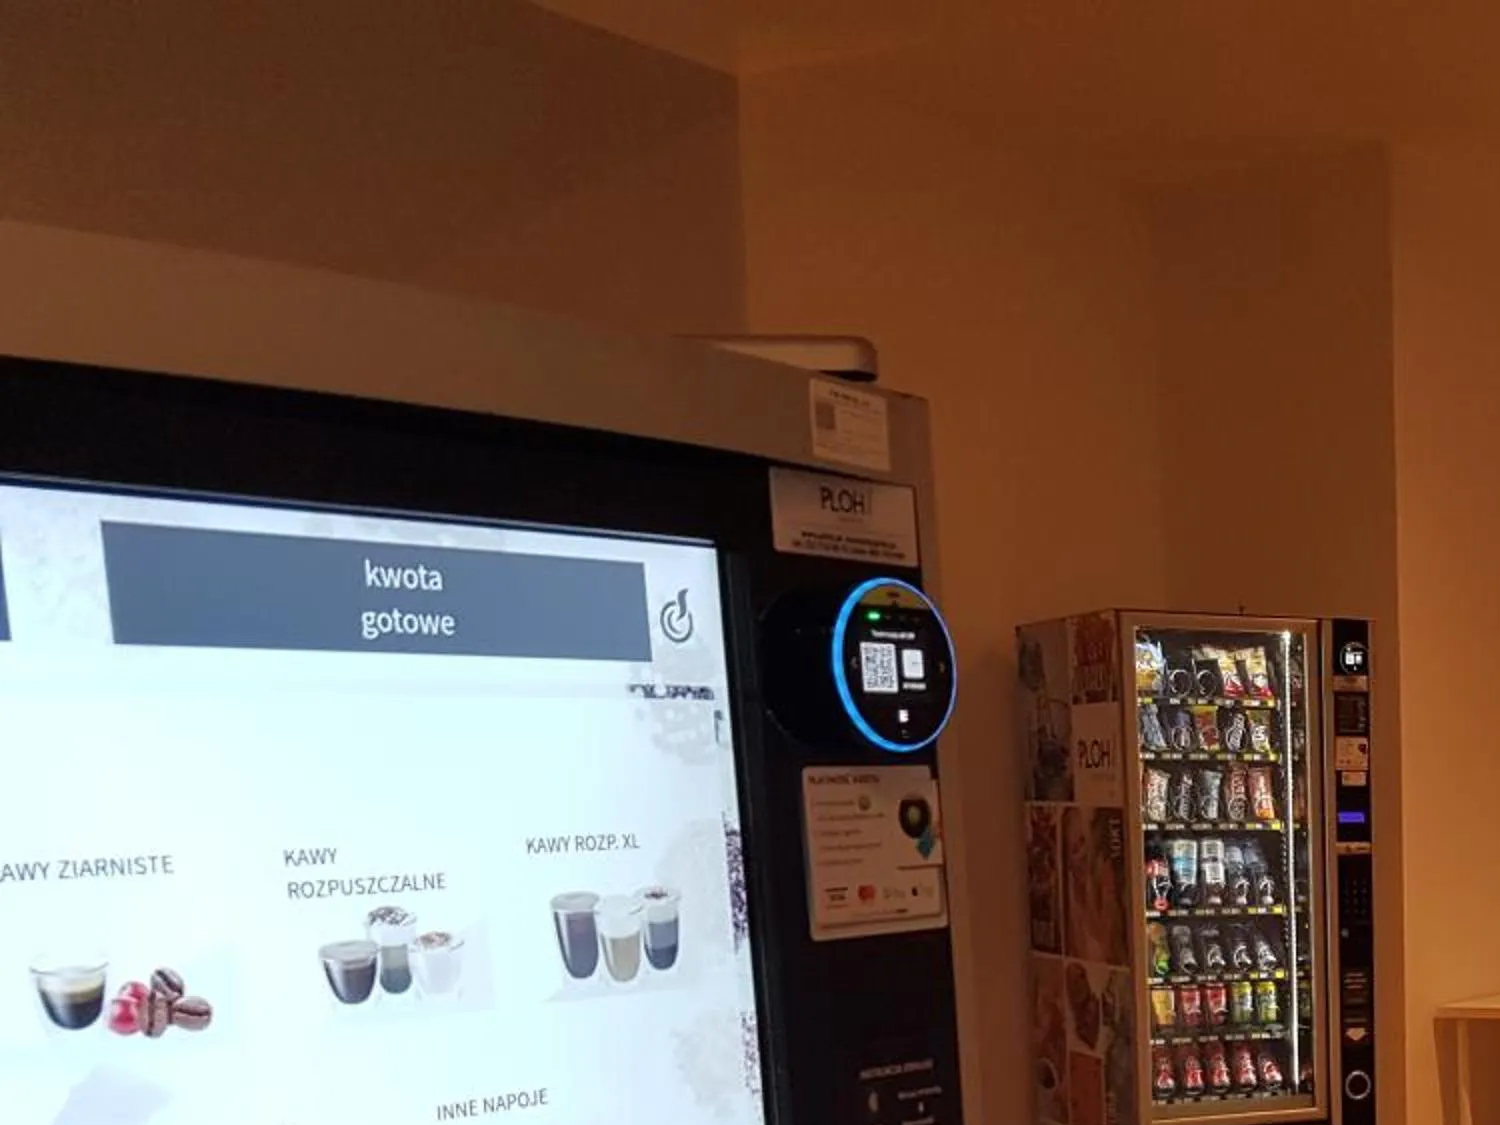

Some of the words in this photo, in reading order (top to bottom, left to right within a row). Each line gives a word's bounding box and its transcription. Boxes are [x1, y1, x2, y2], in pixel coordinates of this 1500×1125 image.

[364, 558, 443, 591] kwota
[361, 607, 456, 640] gotowe
[525, 834, 570, 854] KAWY
[574, 832, 620, 852] ROZP.
[621, 832, 641, 850] XL
[0, 860, 50, 882] AWY
[57, 854, 175, 880] ZIARNISTE
[283, 848, 337, 867] KAWY
[287, 872, 447, 900] ROZPUSZCZALNE
[436, 1099, 479, 1121] INNE
[483, 1087, 549, 1113] NAPOJE
